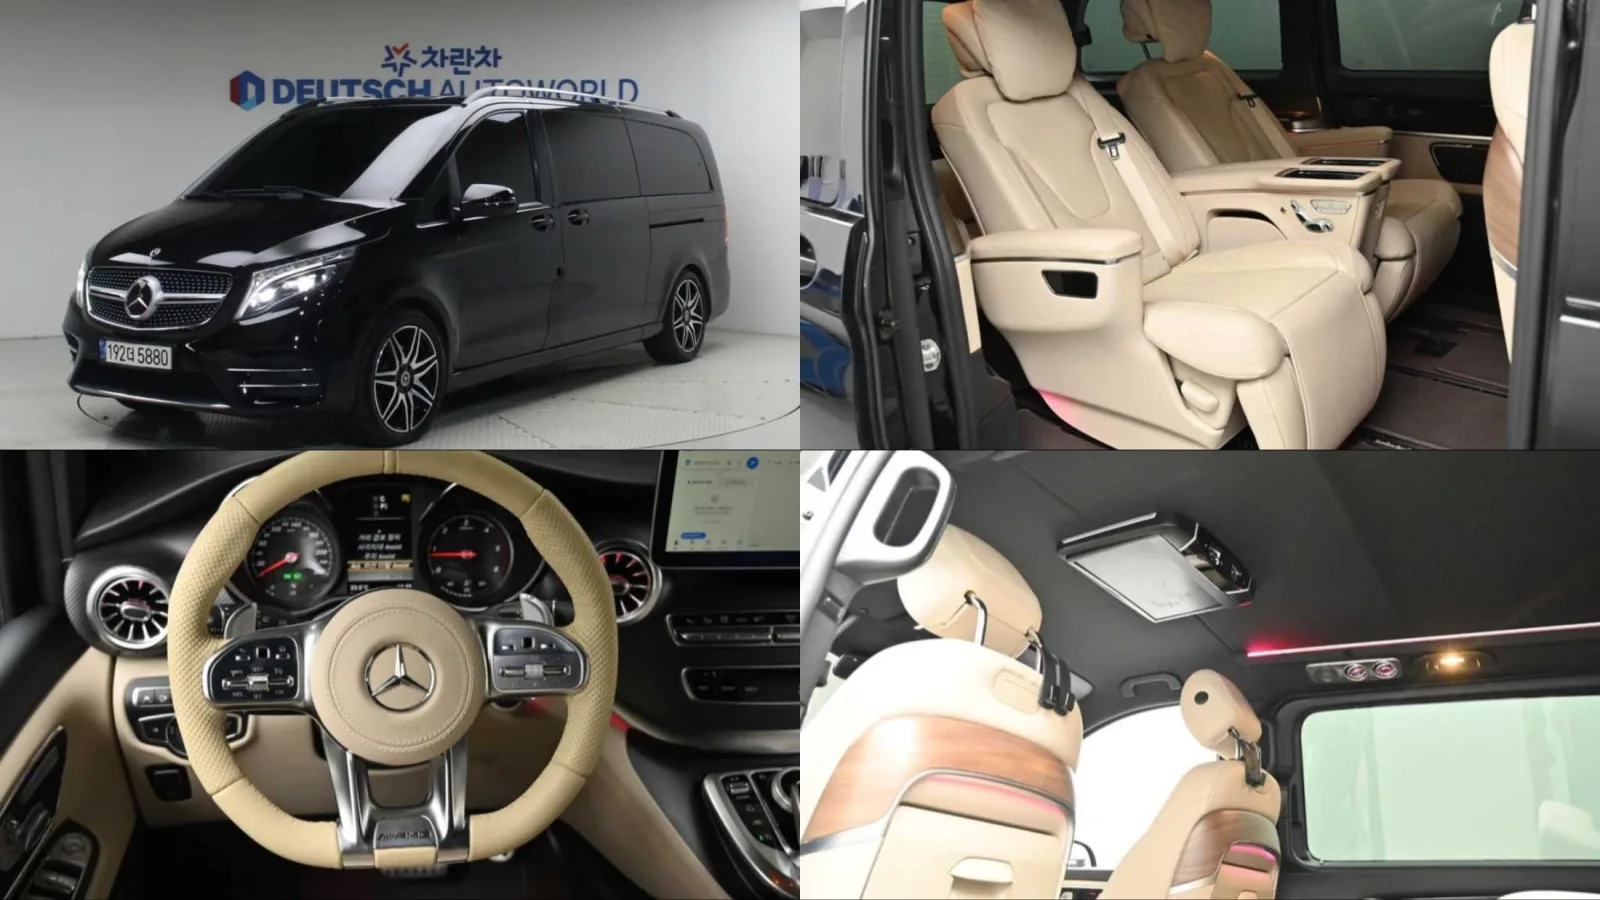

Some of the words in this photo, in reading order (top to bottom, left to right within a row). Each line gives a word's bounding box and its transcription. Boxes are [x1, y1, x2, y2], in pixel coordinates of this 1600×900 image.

[421, 45, 502, 75] 차란차
[273, 78, 431, 104] DEUTSCH
[108, 343, 134, 362] 192더
[137, 347, 168, 366] 5880
